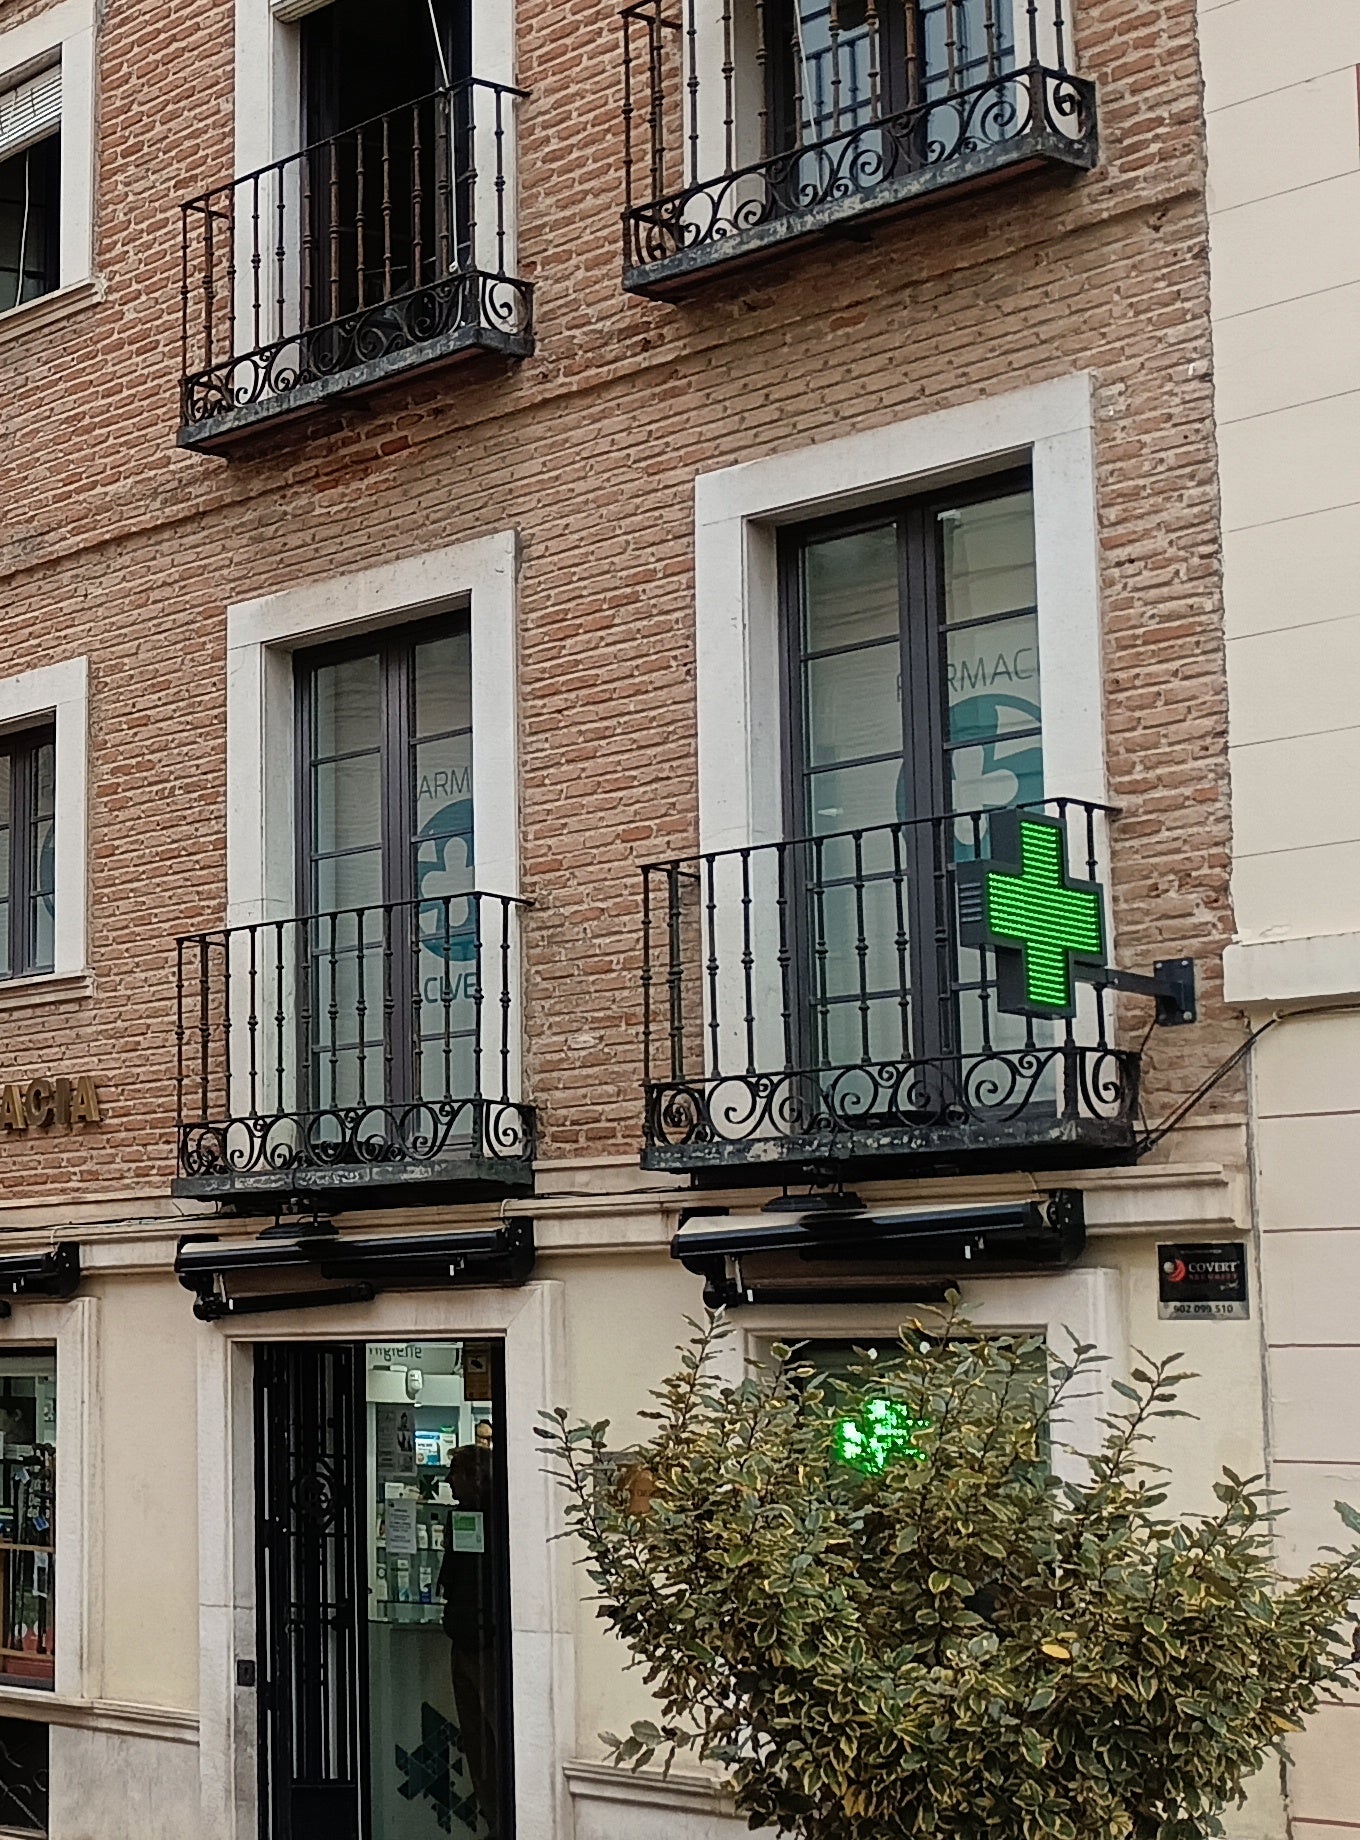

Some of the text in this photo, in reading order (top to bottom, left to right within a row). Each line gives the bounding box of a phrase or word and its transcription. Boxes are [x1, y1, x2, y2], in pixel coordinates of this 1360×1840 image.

[1188, 1261, 1238, 1272] COVERT
[1173, 1304, 1191, 1314] 902
[1215, 1304, 1234, 1313] 510
